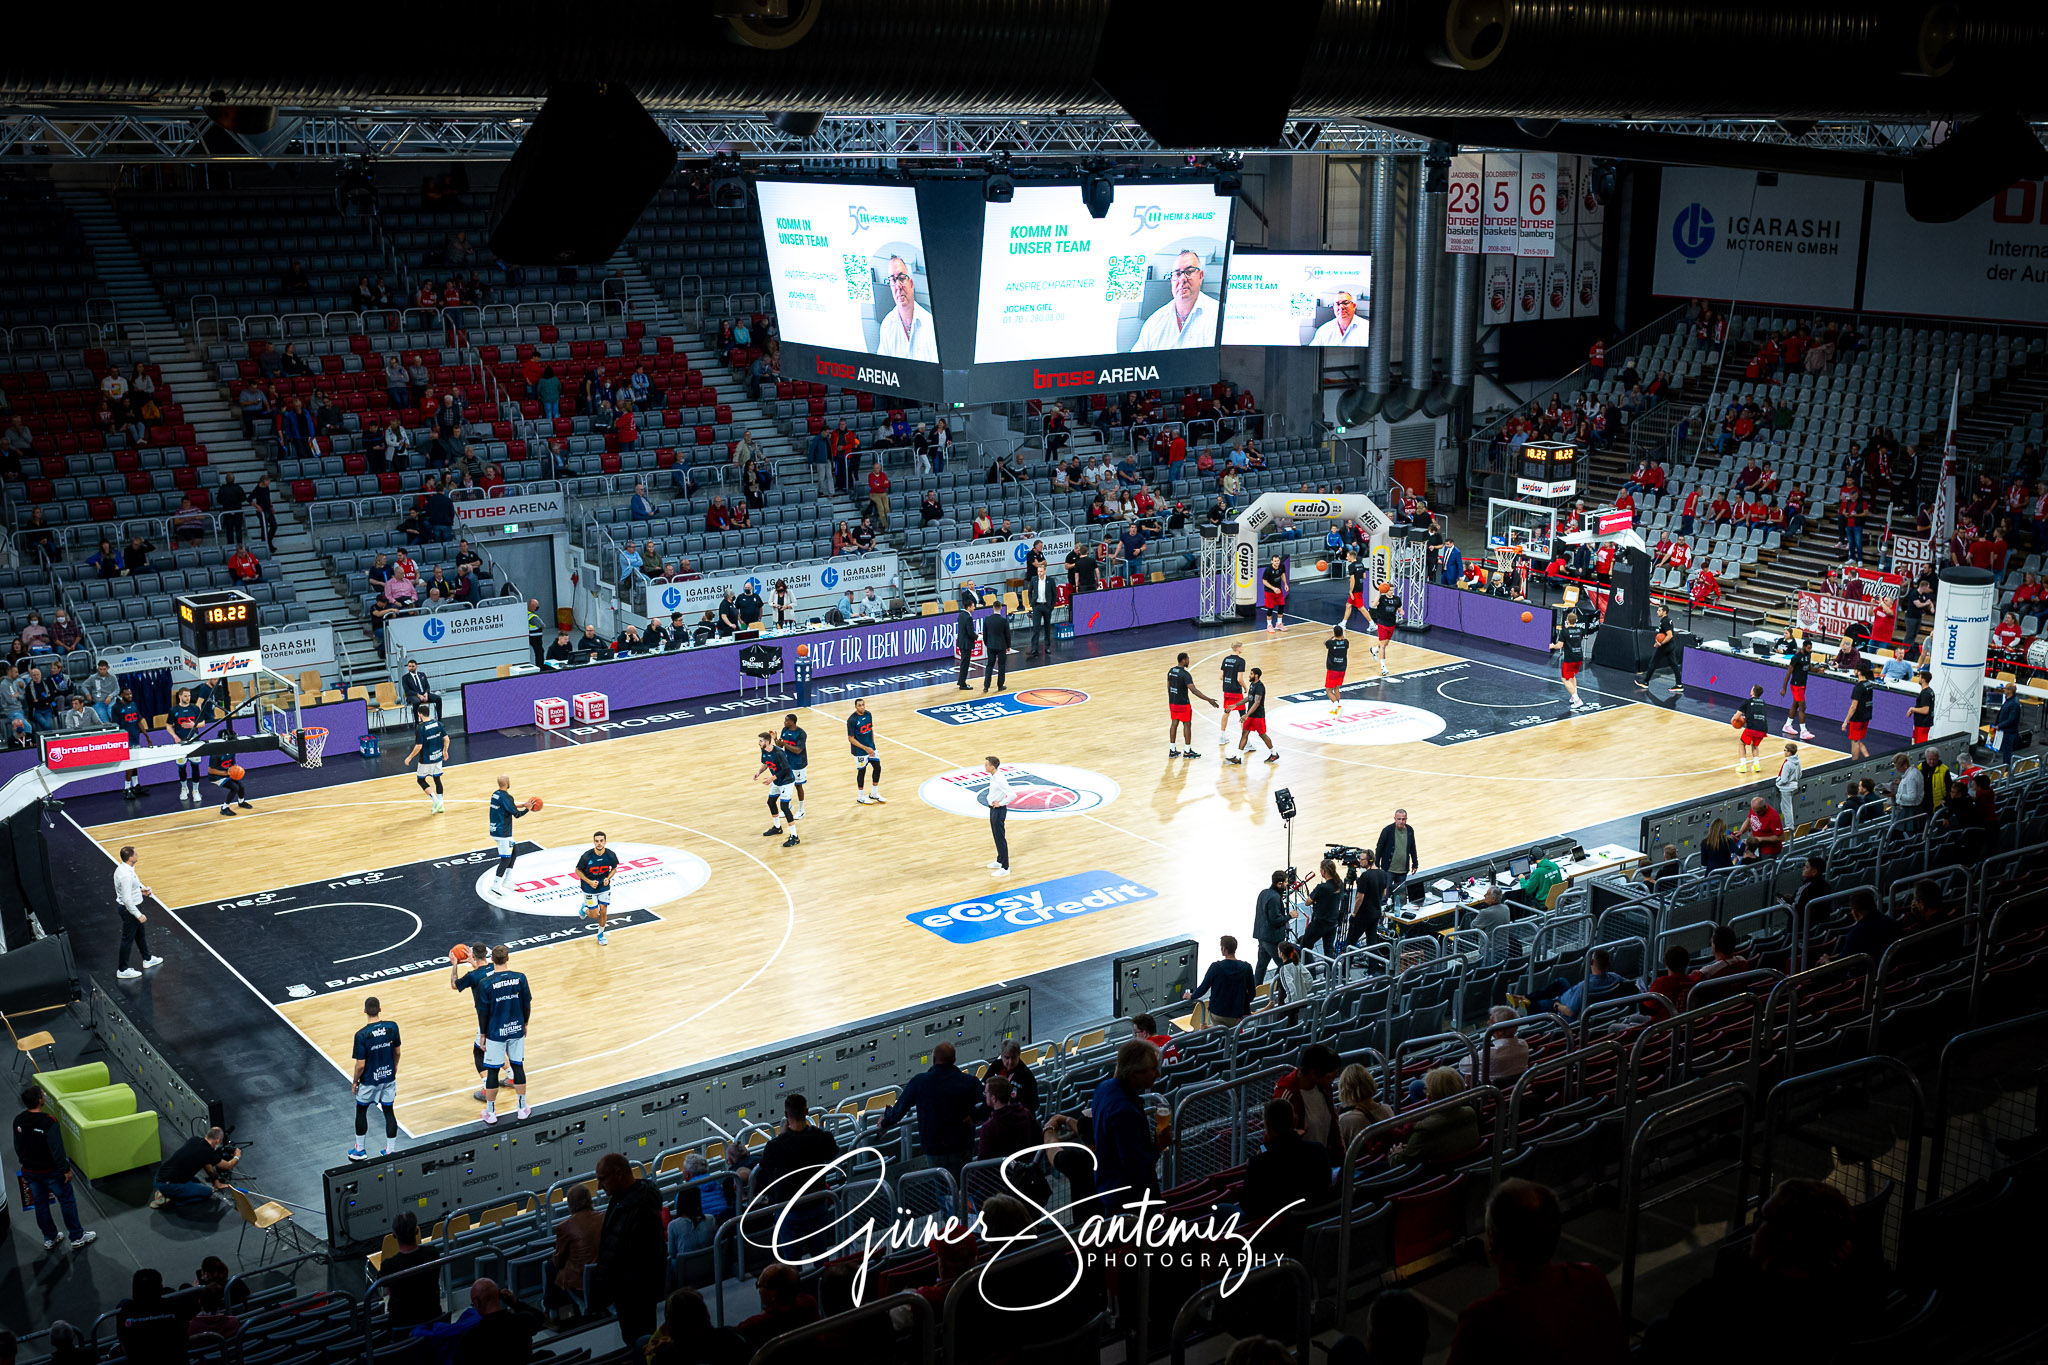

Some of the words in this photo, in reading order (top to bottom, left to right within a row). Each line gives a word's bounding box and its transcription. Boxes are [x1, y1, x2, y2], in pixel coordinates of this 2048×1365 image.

[1448, 182, 1480, 213] 23
[1493, 182, 1509, 212] 5
[1529, 184, 1546, 215] 6
[870, 215, 885, 224] HEIM
[1163, 212, 1184, 221] HEIM
[1185, 211, 1190, 220] &
[1448, 214, 1479, 226] brose
[1484, 214, 1517, 226] brose
[1520, 216, 1554, 228] brose
[777, 217, 801, 230] KOMM
[802, 219, 811, 231] IN
[1447, 226, 1479, 236] baskets
[1483, 226, 1517, 236] baskets
[1728, 216, 1841, 239] IGARASHI
[1010, 225, 1051, 238] KOMM
[1055, 225, 1068, 237] IN
[1520, 229, 1554, 239] bamberg
[779, 233, 804, 245] UNSER
[805, 234, 829, 247] TEAM
[1727, 238, 1792, 253] MOTOREN
[1797, 242, 1839, 256] GMBH
[1009, 241, 1051, 255] UNSER
[1057, 240, 1091, 253] TEAM
[1987, 264, 2017, 281] der
[2020, 265, 2048, 283] Au
[1005, 279, 1095, 292] ANSPRECHPARTNER
[1004, 304, 1036, 313] JOCHEN
[1038, 304, 1053, 312] GIEL
[816, 355, 855, 380] brose
[857, 367, 900, 387] ARENA
[1034, 368, 1095, 389] brose
[1098, 366, 1160, 385] ARENA
[1527, 449, 1547, 460] 18.22
[1555, 449, 1573, 460] 18.22
[457, 506, 505, 520] brose
[509, 501, 558, 515] ARENA
[1293, 503, 1325, 513] radio
[1249, 511, 1267, 528] Hits
[1361, 512, 1379, 530] Hits
[1043, 541, 1072, 551] ARASHI
[1895, 538, 1930, 560] SSB
[966, 550, 1006, 561] IGARASHI
[843, 564, 886, 577] IGARASHI
[1240, 547, 1249, 581] radio
[1377, 553, 1385, 585] radio
[843, 574, 869, 583] MOTOREN
[870, 572, 886, 580] GMBH
[686, 595, 715, 603] MOTOREN
[208, 605, 247, 622] 18.22
[1968, 614, 1989, 623] maxit
[451, 614, 504, 628] IGARASHI
[451, 625, 484, 635] MOTOREN
[484, 623, 504, 631] GMBH
[261, 638, 316, 652] GARASHI
[840, 635, 863, 665] FÜR
[867, 631, 899, 661] LEBEN
[904, 628, 927, 655] UND
[1947, 624, 1958, 660] maxit
[293, 647, 316, 656] GMBH
[1444, 663, 1471, 672] CITY
[570, 710, 695, 736] BROSE
[704, 692, 797, 715] AREN
[819, 665, 977, 696] BAMBERG
[950, 708, 1023, 724] BBL
[1289, 707, 1398, 731] brose
[1004, 884, 1148, 926] Credit
[325, 957, 451, 988] BAMBERG
[504, 927, 578, 949] FREAK
